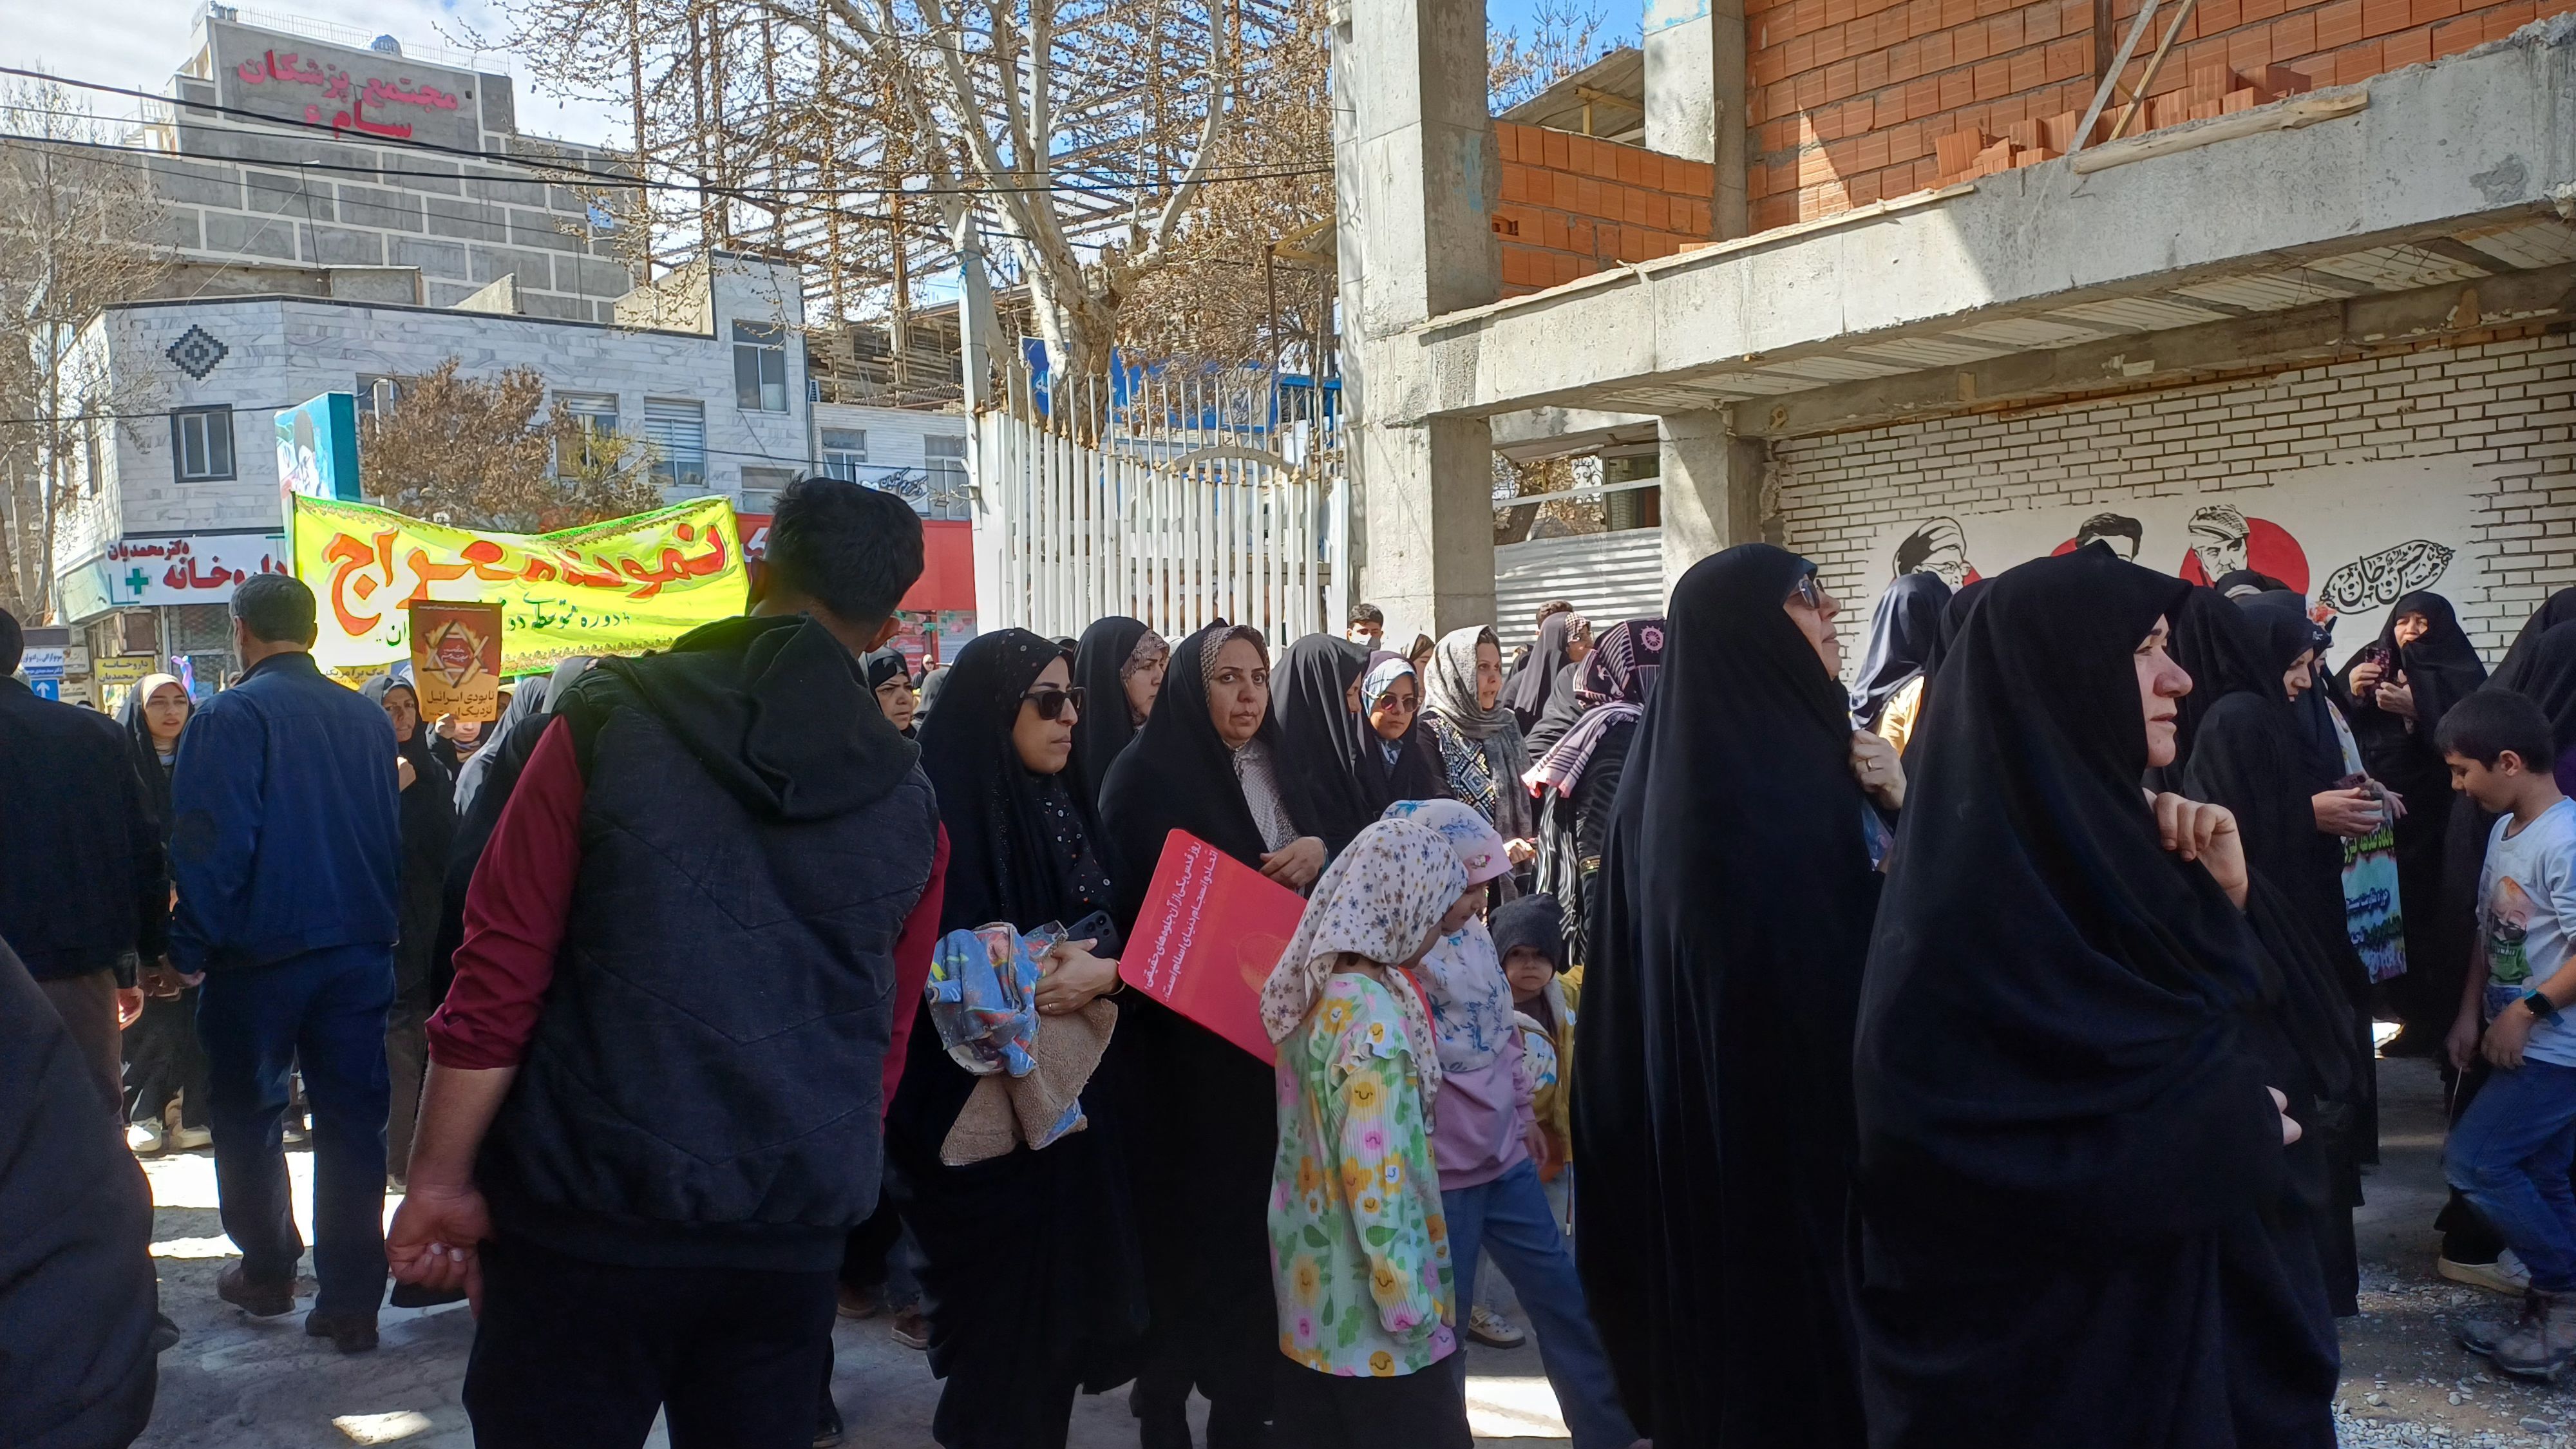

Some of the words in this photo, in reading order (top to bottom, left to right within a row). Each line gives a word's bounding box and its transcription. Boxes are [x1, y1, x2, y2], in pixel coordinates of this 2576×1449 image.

[238, 49, 350, 104] پزشکان
[362, 77, 459, 113] مجتمع
[332, 99, 412, 139] سام
[108, 541, 165, 562] محمدیان
[164, 539, 189, 560] دکتر
[464, 690, 495, 705] نابودی
[461, 706, 493, 718] نزدیک
[1185, 841, 1201, 858] روز
[1182, 851, 1195, 880] قدس
[1175, 876, 1189, 898] یکی
[1166, 893, 1182, 907] از
[1166, 899, 1179, 918] آن
[1190, 879, 1208, 920] انسجام
[1181, 917, 1196, 948] دنیای
[1171, 943, 1187, 975] اسلام
